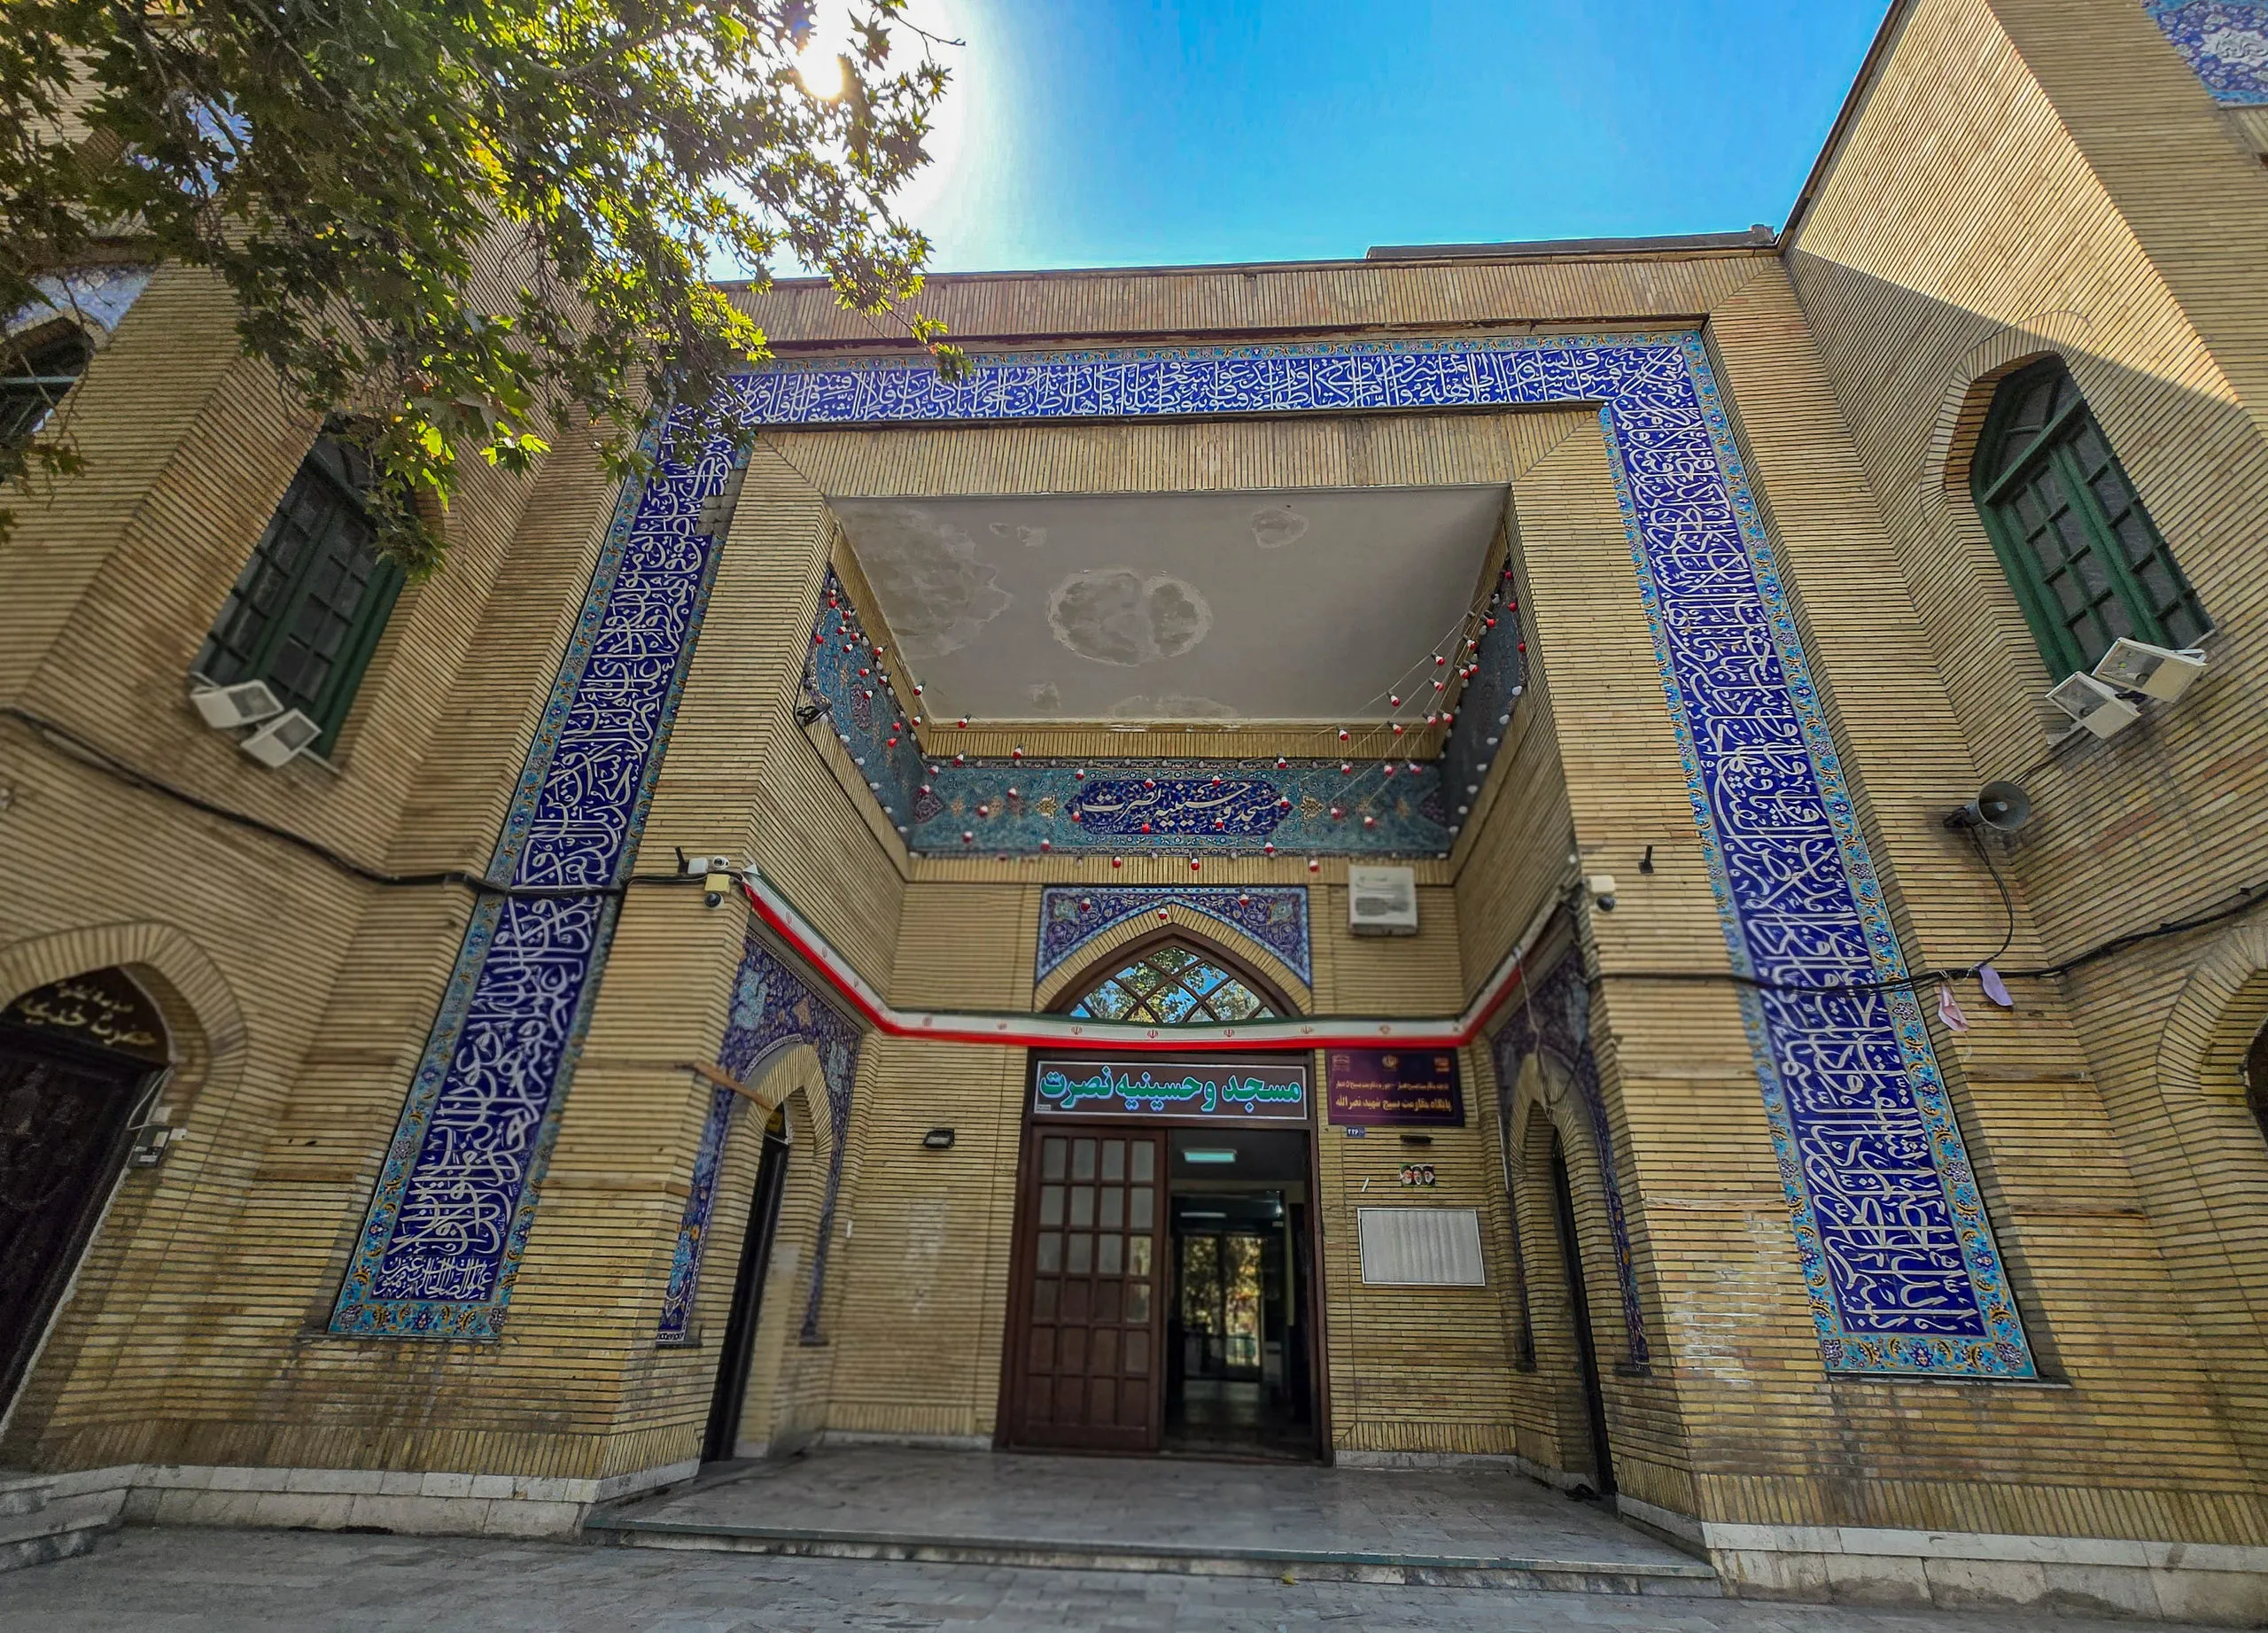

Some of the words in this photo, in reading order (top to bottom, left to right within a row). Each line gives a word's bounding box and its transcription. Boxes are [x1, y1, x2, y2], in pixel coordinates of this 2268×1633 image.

[1039, 1065, 1114, 1109] نصرت
[1115, 1070, 1203, 1111] حسینیه
[1200, 1079, 1218, 1113] و
[1222, 1072, 1302, 1114] مسجد
[1363, 1096, 1380, 1110] شهید
[1382, 1100, 1401, 1111] بسیج
[1402, 1097, 1429, 1112] مقاومت
[1430, 1099, 1452, 1112] پایگاه
